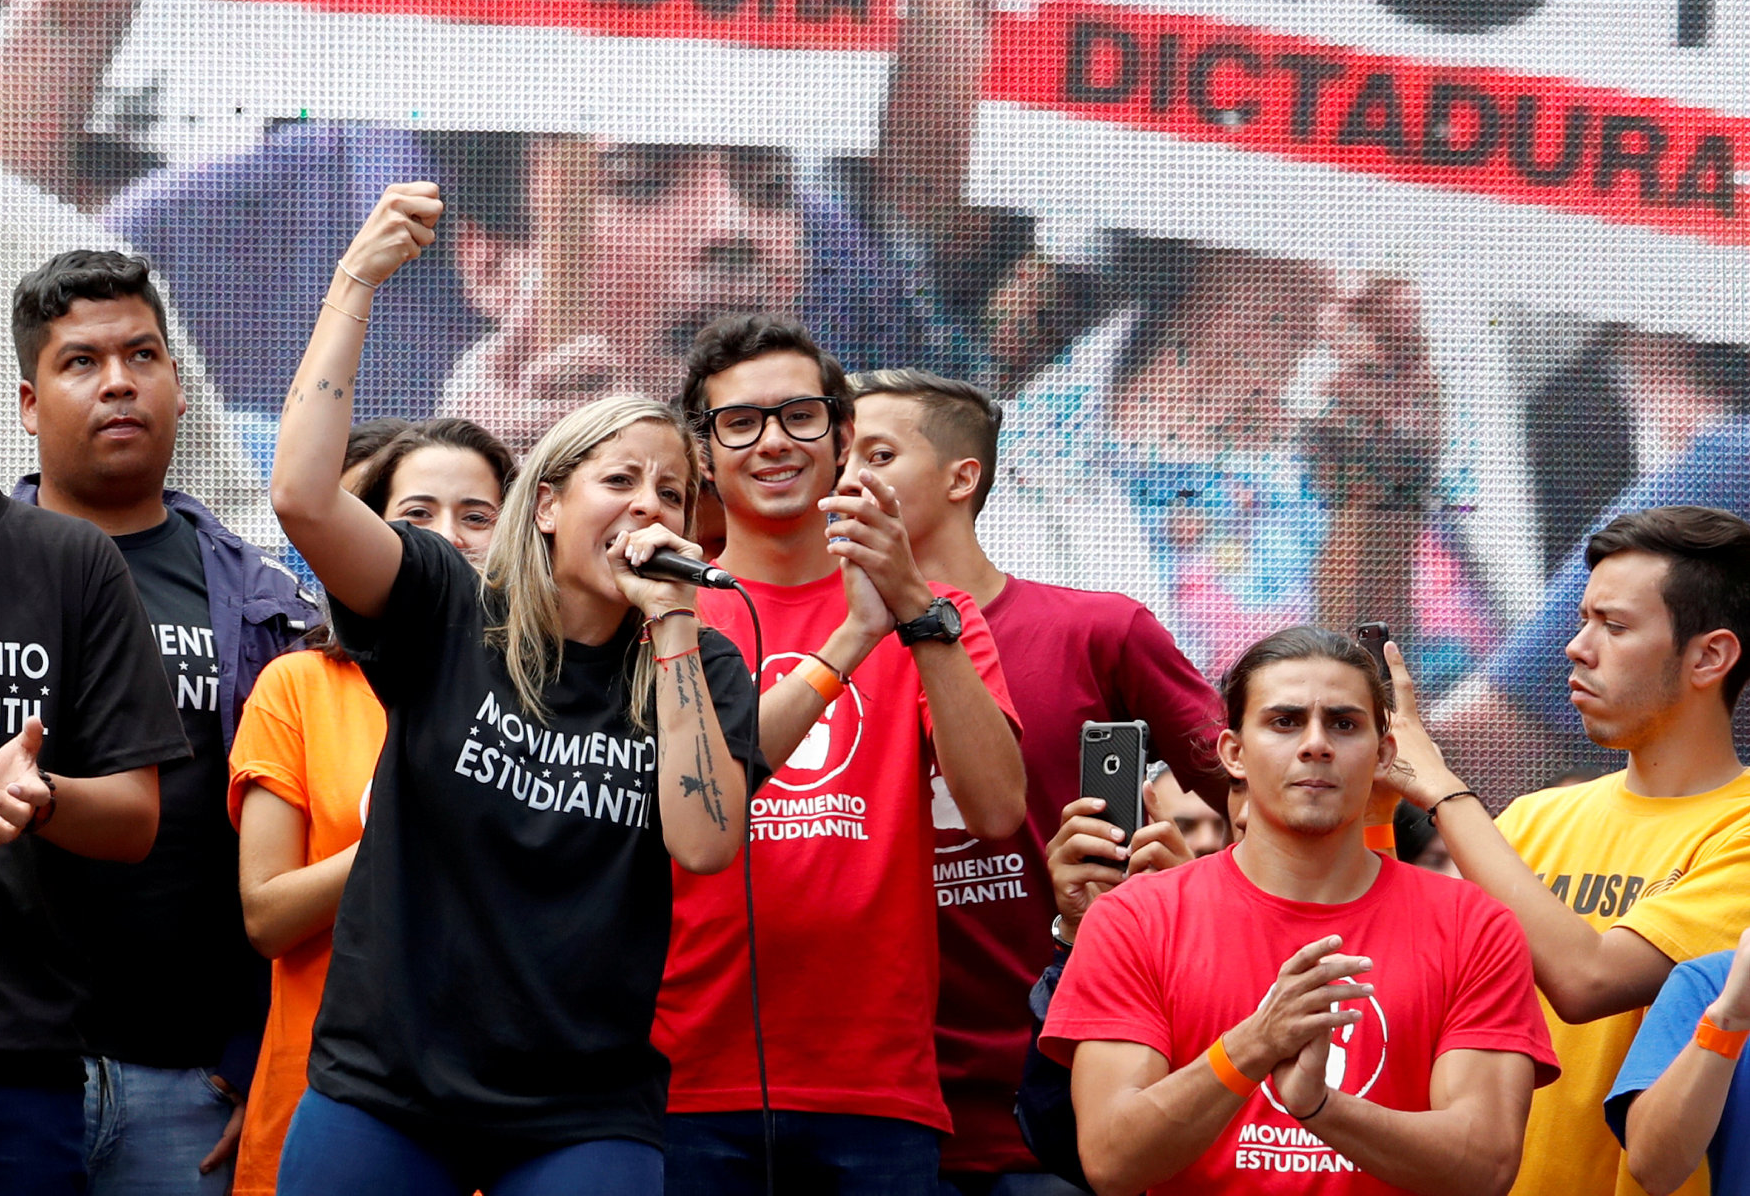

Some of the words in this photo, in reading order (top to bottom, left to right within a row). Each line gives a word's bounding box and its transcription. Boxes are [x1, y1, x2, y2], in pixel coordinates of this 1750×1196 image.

[1063, 17, 1736, 219] DICTADURA
[475, 690, 657, 773] MOVIMIENTO
[454, 739, 653, 831] ESTUDIANTIL
[750, 793, 867, 817] OVIMIENTO
[750, 818, 869, 842] TUDIANTIL
[932, 853, 1024, 882] IMIENTO
[936, 879, 1028, 907] DIANTIL
[1238, 1123, 1325, 1146] MOVIM
[1235, 1149, 1362, 1173] ESTUDIAN
